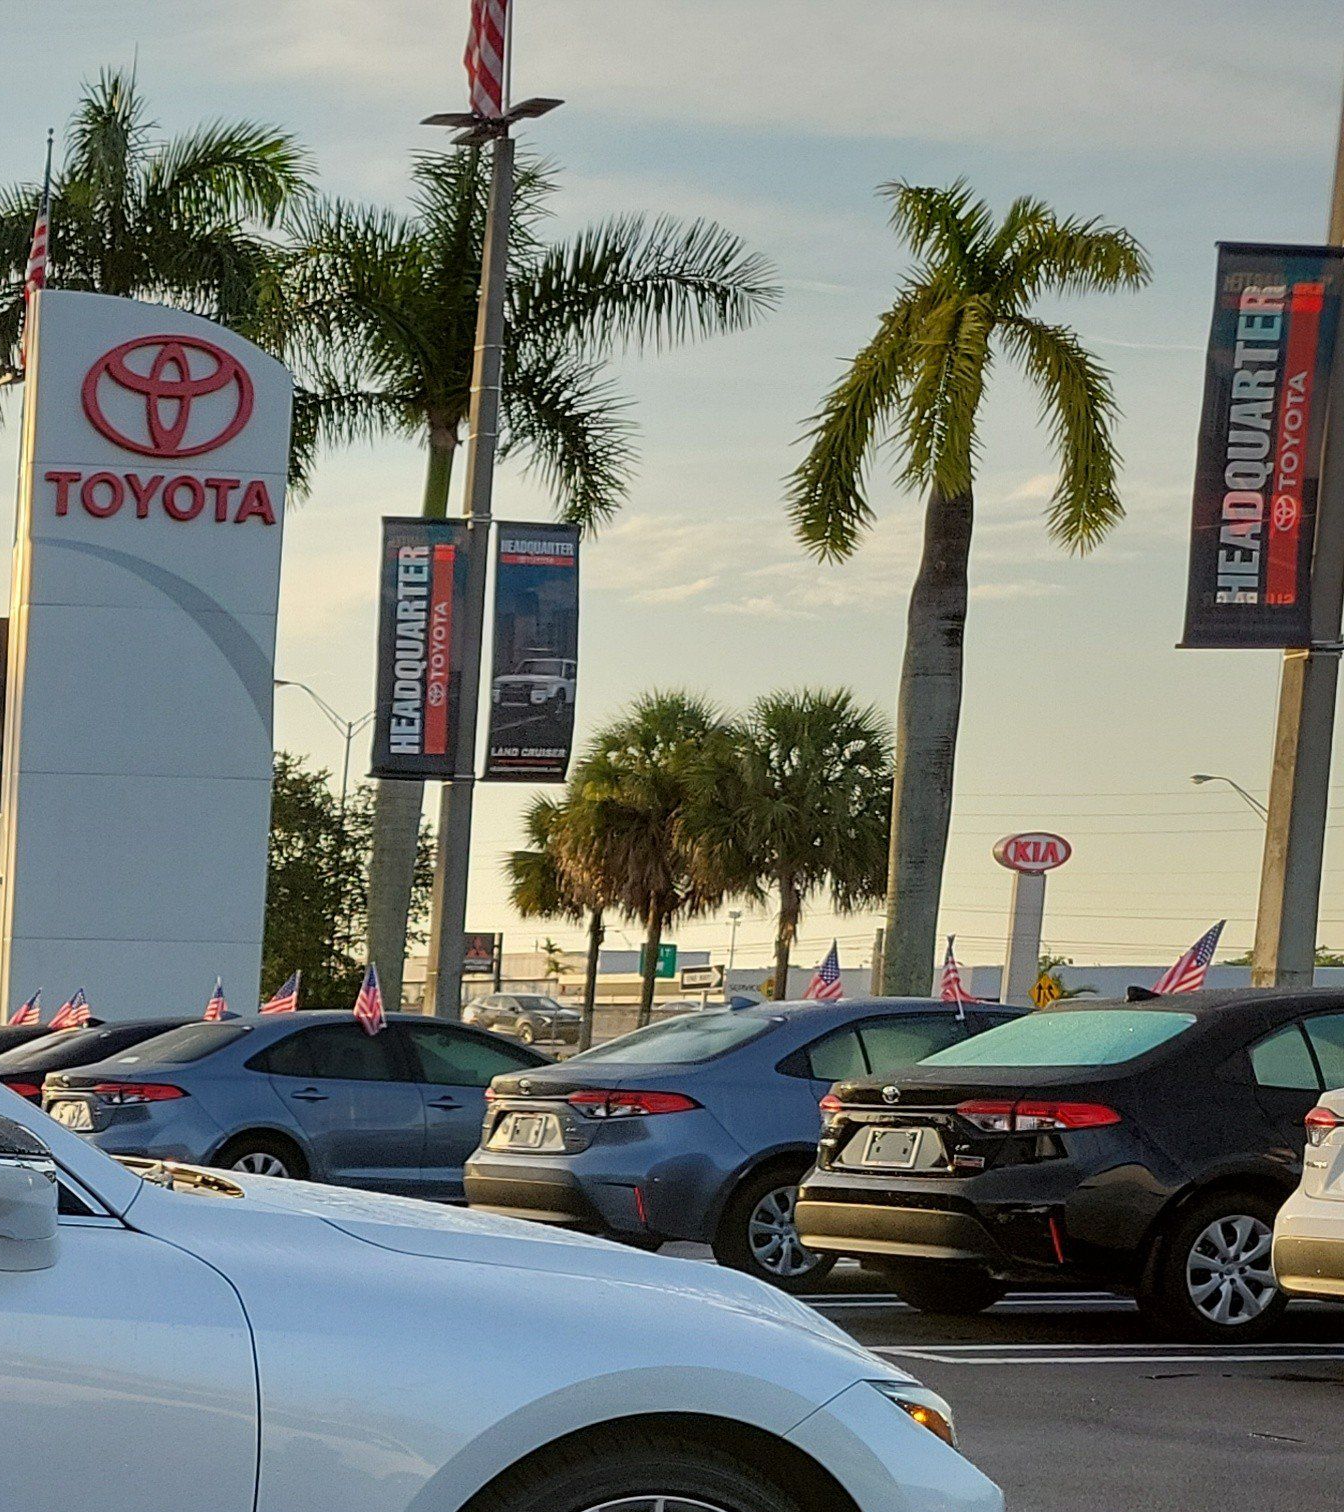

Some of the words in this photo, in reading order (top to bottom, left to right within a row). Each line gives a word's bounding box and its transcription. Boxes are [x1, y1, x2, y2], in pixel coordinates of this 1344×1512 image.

[1216, 284, 1288, 605] HEADQUARTER
[1277, 370, 1309, 492] TOYOTA
[44, 470, 277, 526] TOYOTA
[500, 538, 575, 557] HEADQUARTER
[389, 545, 431, 755] HEADQUARTER
[430, 601, 448, 678] TOYOTA
[490, 746, 520, 758] LAND
[520, 747, 568, 759] CRUISER
[1013, 842, 1060, 862] KIA
